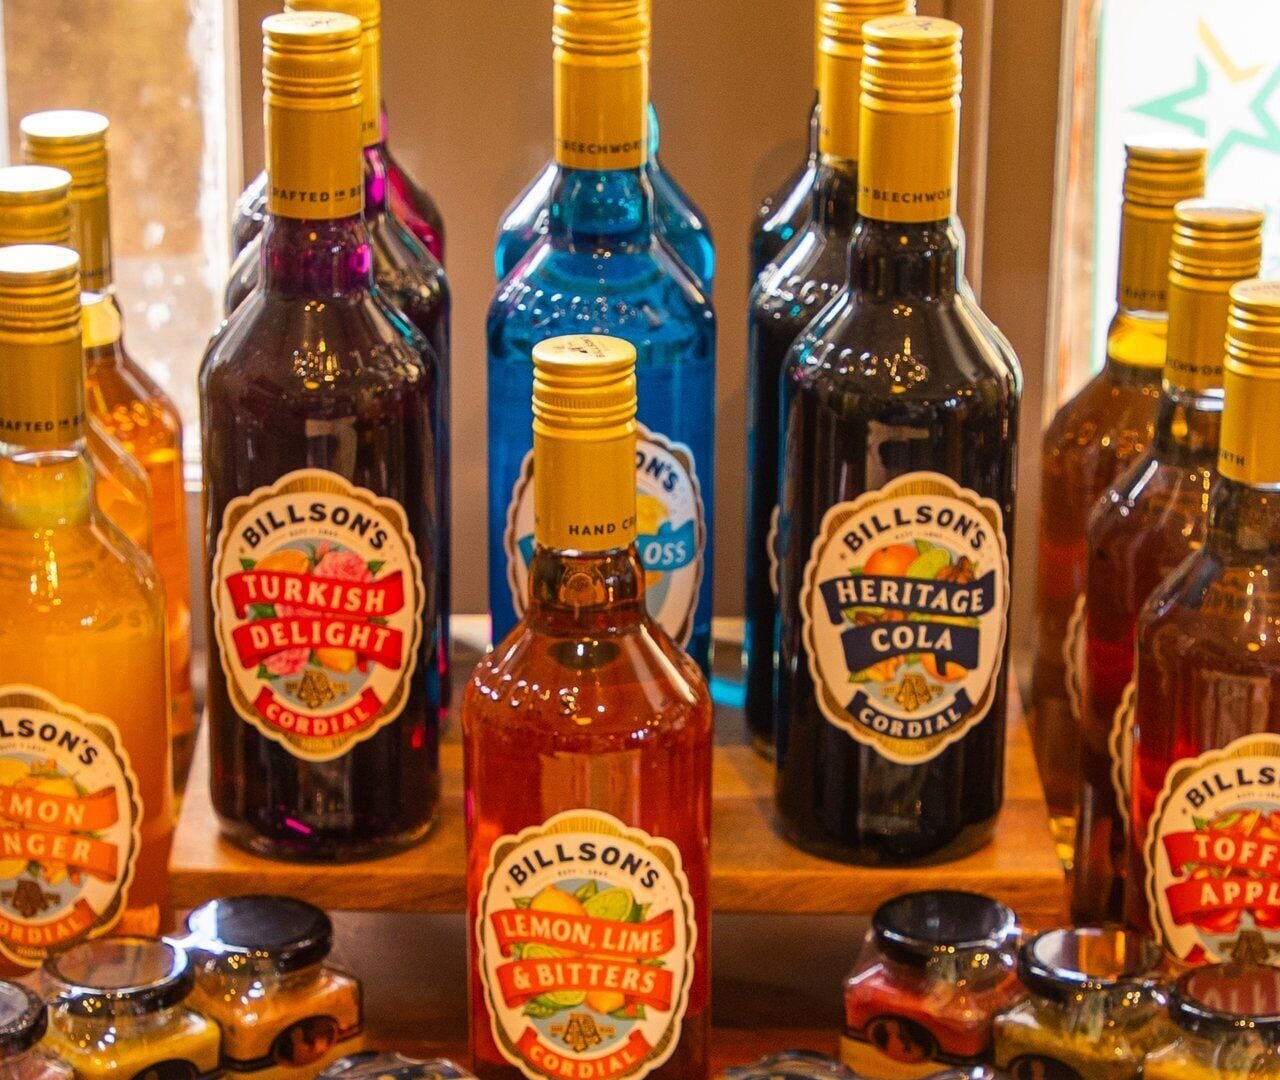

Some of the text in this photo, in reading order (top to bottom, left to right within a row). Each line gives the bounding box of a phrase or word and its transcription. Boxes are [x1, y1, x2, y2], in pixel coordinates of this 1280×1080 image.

[242, 502, 388, 549] BILLSON'S
[568, 523, 616, 536] HAND
[842, 505, 986, 552] BILLSON'S
[242, 575, 386, 613] TURKISH
[836, 579, 985, 614] HERITAGE
[250, 621, 391, 652] DELIGHT
[871, 625, 953, 652] COLA
[265, 703, 370, 735] CORDIAL
[859, 707, 962, 738] CORDIAL
[507, 842, 660, 889] BILLSON'S
[602, 926, 664, 954] LIME
[512, 963, 657, 994] & BITTERS
[530, 1045, 638, 1080] CORDIAL
